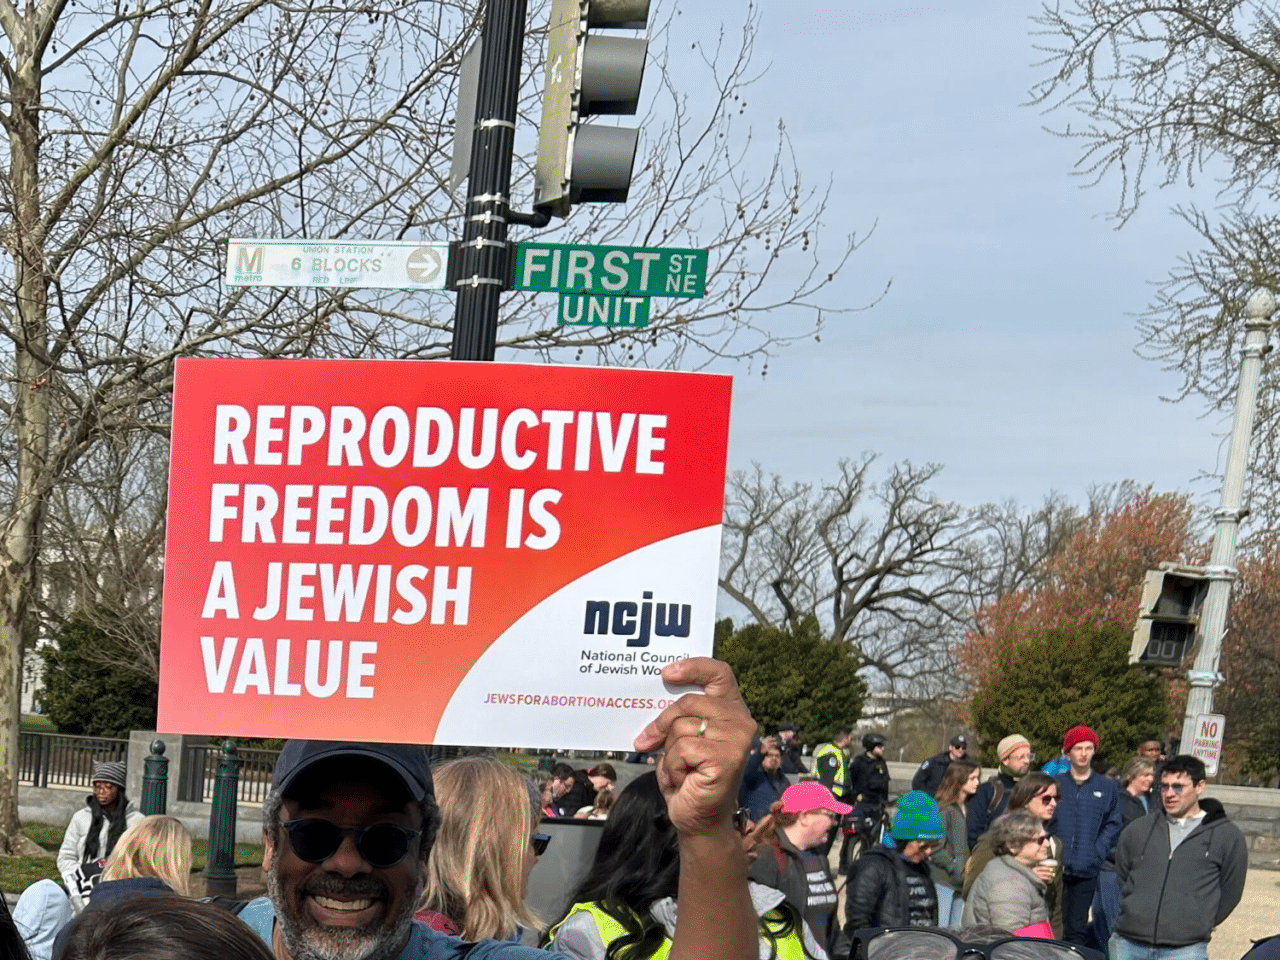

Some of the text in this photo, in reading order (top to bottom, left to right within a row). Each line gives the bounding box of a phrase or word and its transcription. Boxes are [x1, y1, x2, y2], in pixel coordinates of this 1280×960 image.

[303, 246, 373, 255] UNION STATION
[291, 257, 382, 273] 6 BLOCKS
[522, 248, 661, 292] FIRST
[669, 254, 697, 274] ST
[665, 274, 697, 294] NE
[562, 296, 644, 324] UNIT
[213, 404, 668, 476] REPRODUCTIVE
[209, 483, 562, 550] FREEDOM IS
[202, 561, 472, 627] A JEWISH
[583, 591, 692, 647] ncjw
[581, 650, 636, 663] National
[200, 637, 378, 699] VALUE
[579, 664, 592, 675] of
[595, 665, 638, 676] Jewish
[1201, 721, 1218, 738] NO
[1192, 748, 1217, 759] ANYTIME
[1194, 738, 1219, 749] PARKING
